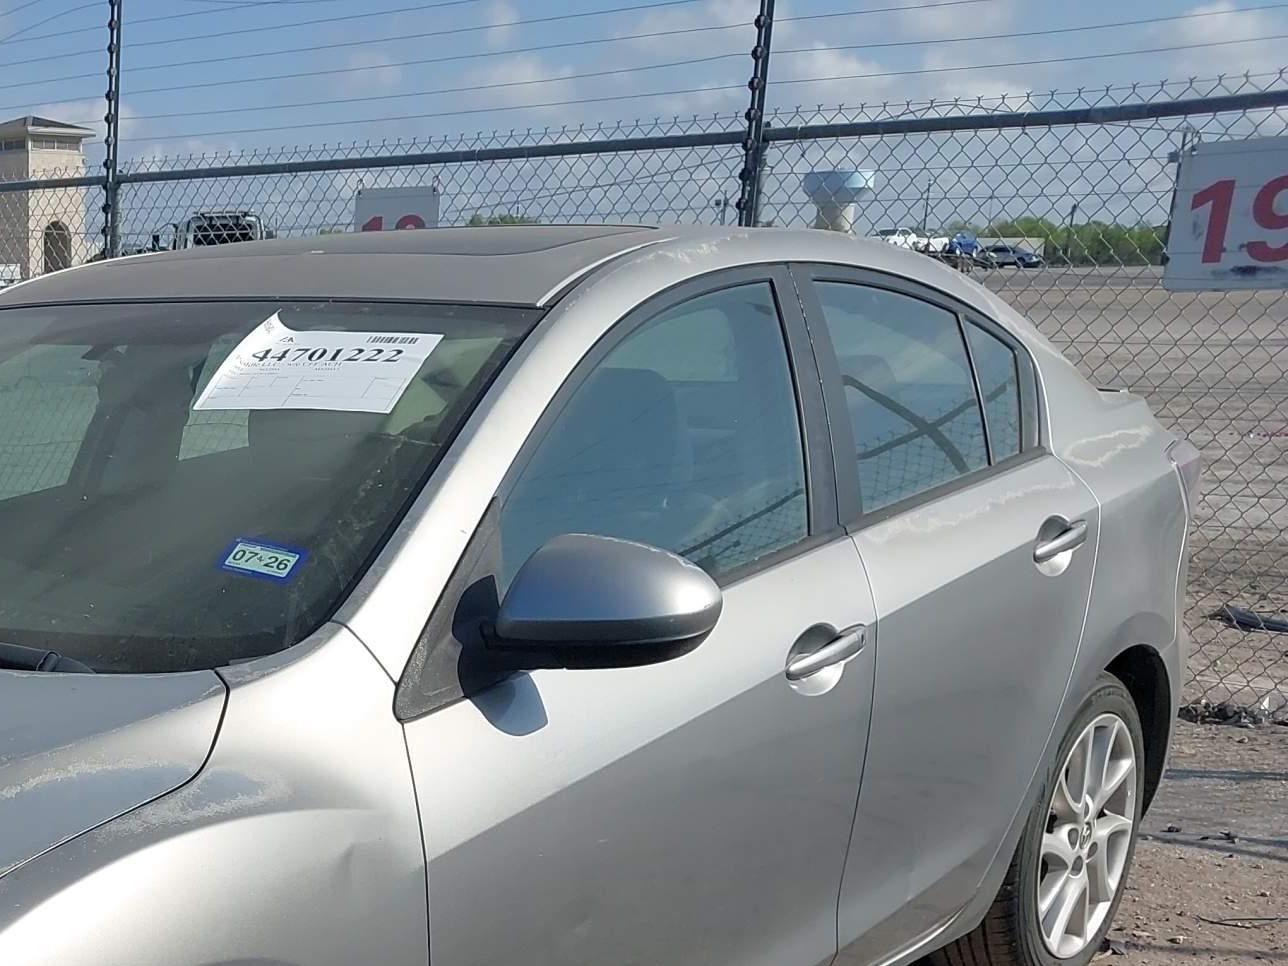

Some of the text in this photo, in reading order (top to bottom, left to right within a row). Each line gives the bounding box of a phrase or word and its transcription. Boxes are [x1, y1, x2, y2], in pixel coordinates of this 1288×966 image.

[251, 347, 405, 363] 44701222
[231, 549, 291, 571] 07 26
